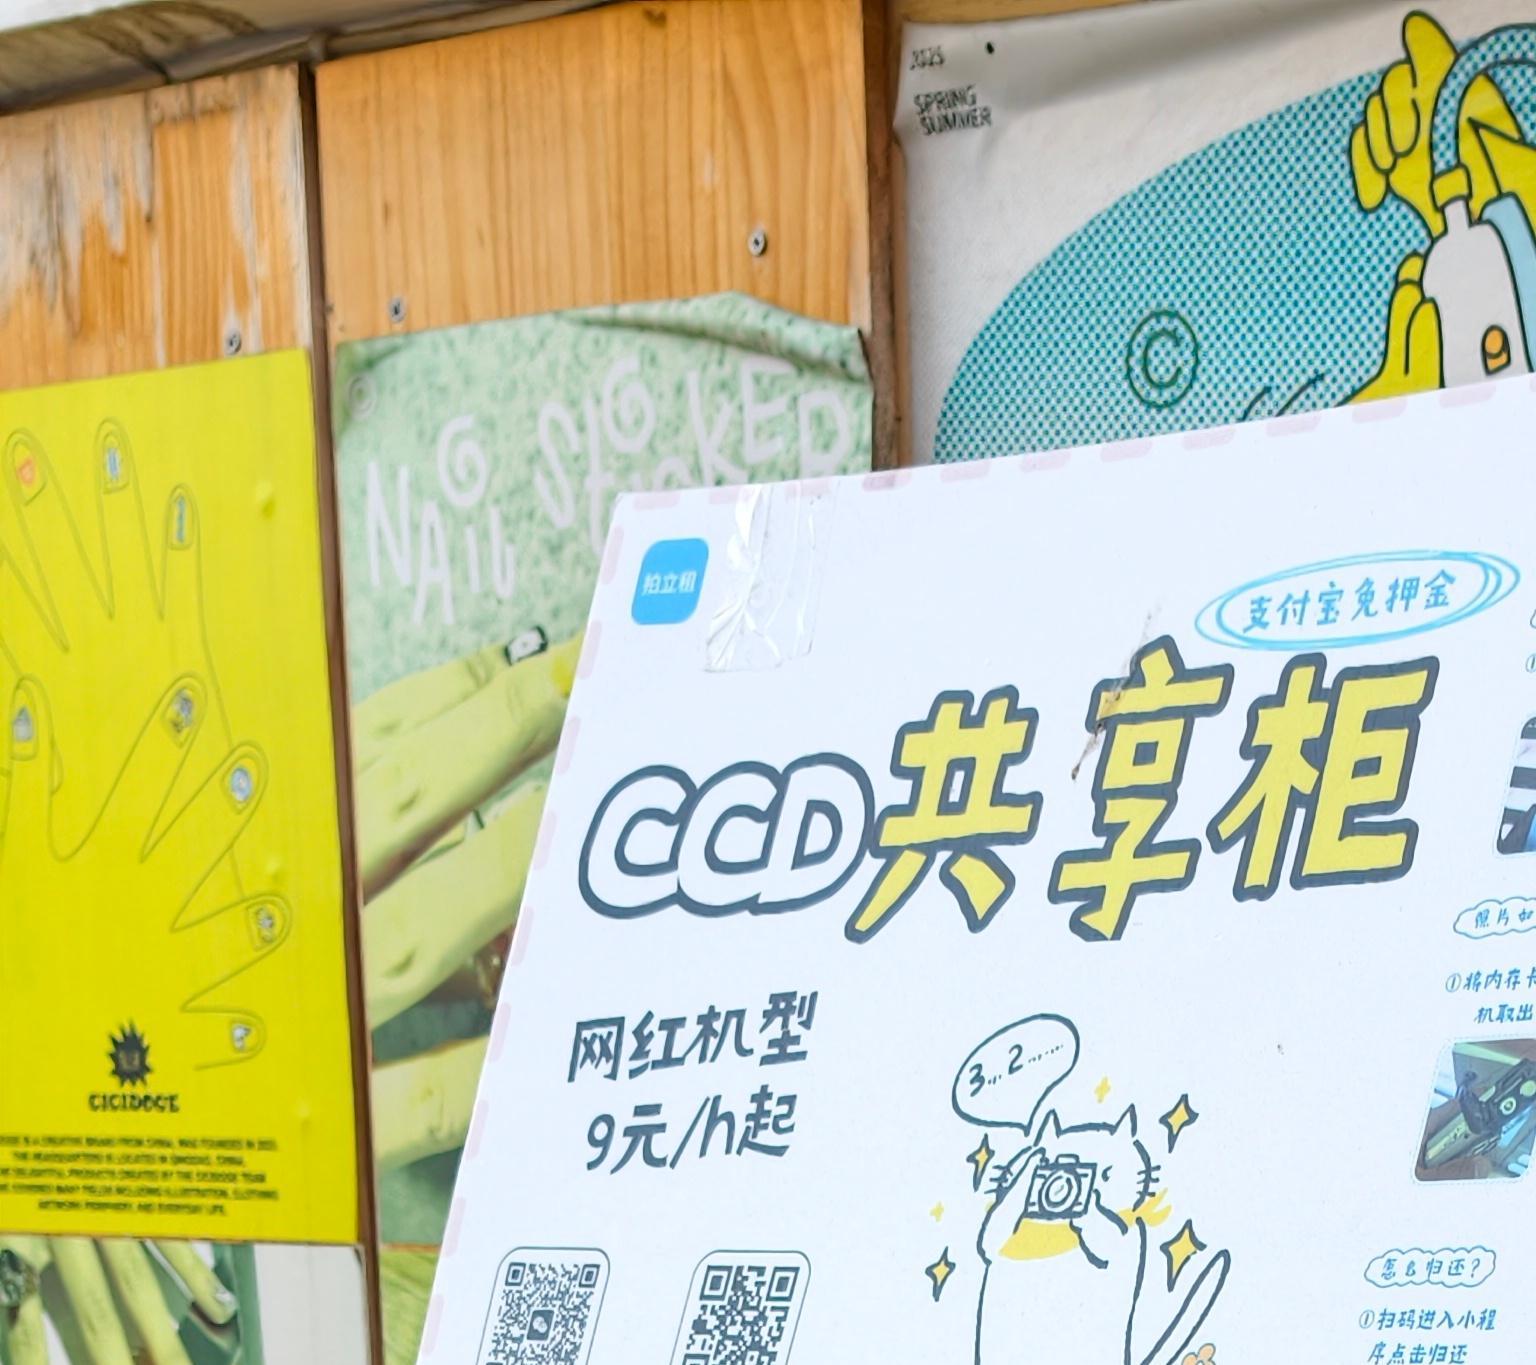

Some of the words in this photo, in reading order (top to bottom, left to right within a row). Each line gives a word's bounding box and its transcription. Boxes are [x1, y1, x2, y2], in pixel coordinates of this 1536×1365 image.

[913, 84, 977, 115] SPRING
[920, 106, 992, 135] SUMMER
[642, 571, 698, 597] 拍立租
[1243, 569, 1457, 634] 支付宝免押金
[1473, 1003, 1534, 1024] 机取出
[566, 991, 819, 1083] 网红机型
[585, 1084, 798, 1175] 9元/h起
[1366, 1341, 1468, 1365] 序点击归还
